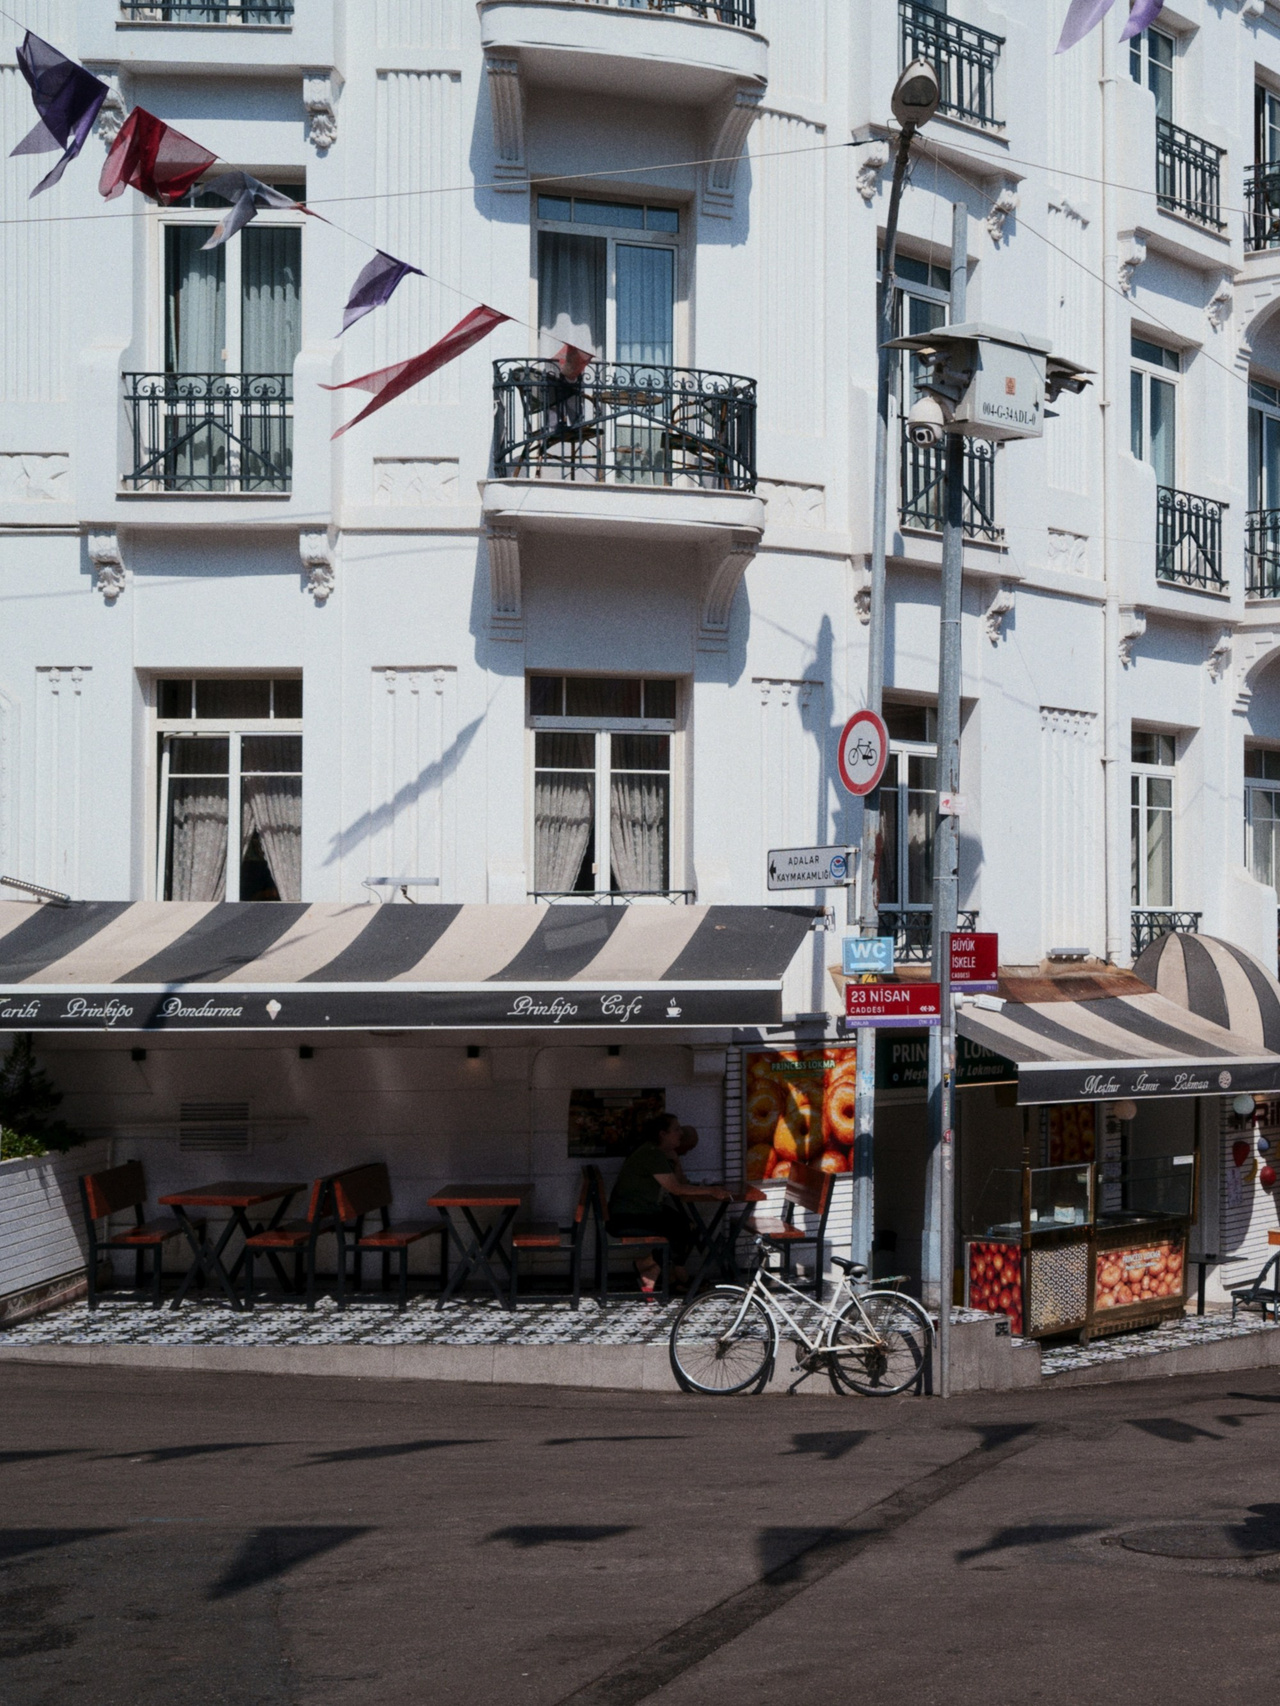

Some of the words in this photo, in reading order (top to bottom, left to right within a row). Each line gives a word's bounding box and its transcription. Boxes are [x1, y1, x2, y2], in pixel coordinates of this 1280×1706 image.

[788, 855, 820, 866] ADALAR
[776, 869, 831, 882] KAYMAKAMLIĞI
[850, 942, 886, 959] WC
[952, 938, 975, 952] BÜYÜK
[952, 955, 976, 968] İSKELE
[851, 990, 866, 1003] 23
[870, 989, 910, 1003] NİSAN
[61, 997, 134, 1025] Prinkipo
[157, 997, 243, 1018] Dondurma
[507, 995, 579, 1023] Prinkipo
[600, 994, 643, 1022] Cafe
[850, 1005, 885, 1014] CADDESİ
[771, 1061, 807, 1071] PRINCESS
[808, 1059, 836, 1070] LOKMA
